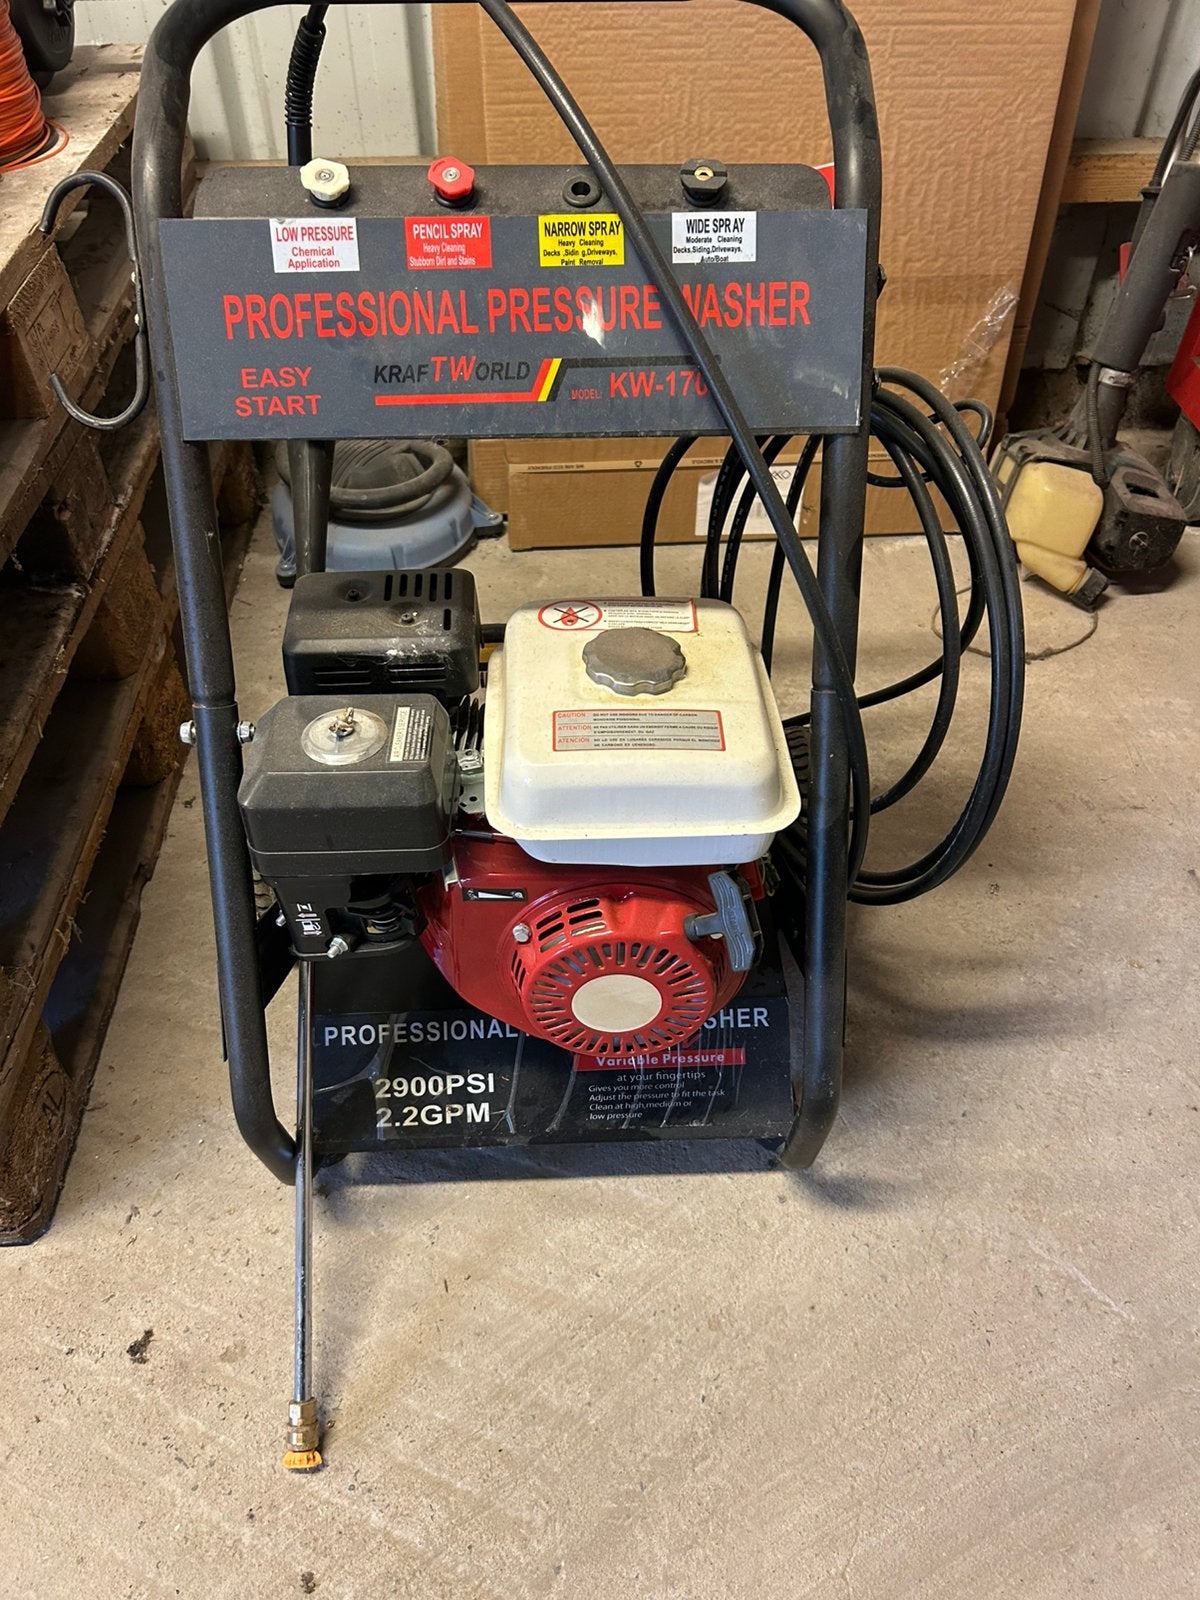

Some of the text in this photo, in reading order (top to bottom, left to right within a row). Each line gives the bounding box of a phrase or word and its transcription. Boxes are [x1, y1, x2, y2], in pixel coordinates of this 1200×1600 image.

[412, 222, 483, 240] PENCIL SPRAY
[544, 221, 588, 237] NARROW
[686, 218, 710, 234] WIDE
[276, 225, 354, 242] LOW PRESSURE
[717, 235, 743, 244] Cleaning
[423, 242, 466, 255] Heavy Cleaning
[558, 239, 604, 247] Heavy Cleaning
[291, 246, 335, 257] Chemical
[287, 258, 340, 270] Application
[409, 255, 476, 267] Stubborn Dirt and Stains
[223, 289, 479, 340] PROFESSIONAL
[487, 284, 662, 334] PRESSURE
[373, 355, 531, 384] KRAFTWORLD
[240, 367, 312, 389] EASY
[235, 394, 321, 417] START
[324, 1019, 519, 1046] PROFESSIONAL
[596, 1053, 725, 1067] Variable Pressure
[630, 1073, 652, 1082] your
[656, 1070, 706, 1081] fingertips
[375, 1073, 495, 1098] 2900PSI
[588, 1084, 611, 1092] Gives
[654, 1081, 685, 1089] control
[589, 1093, 616, 1102] Adjust
[618, 1092, 632, 1100] the
[634, 1091, 670, 1101] pressure
[681, 1089, 690, 1097] fit
[692, 1089, 707, 1097] the
[708, 1088, 725, 1096] task
[589, 1102, 613, 1111] Clean
[614, 1102, 623, 1110] at
[376, 1102, 491, 1128] 2.2GPM
[589, 1111, 643, 1120] low pressure
